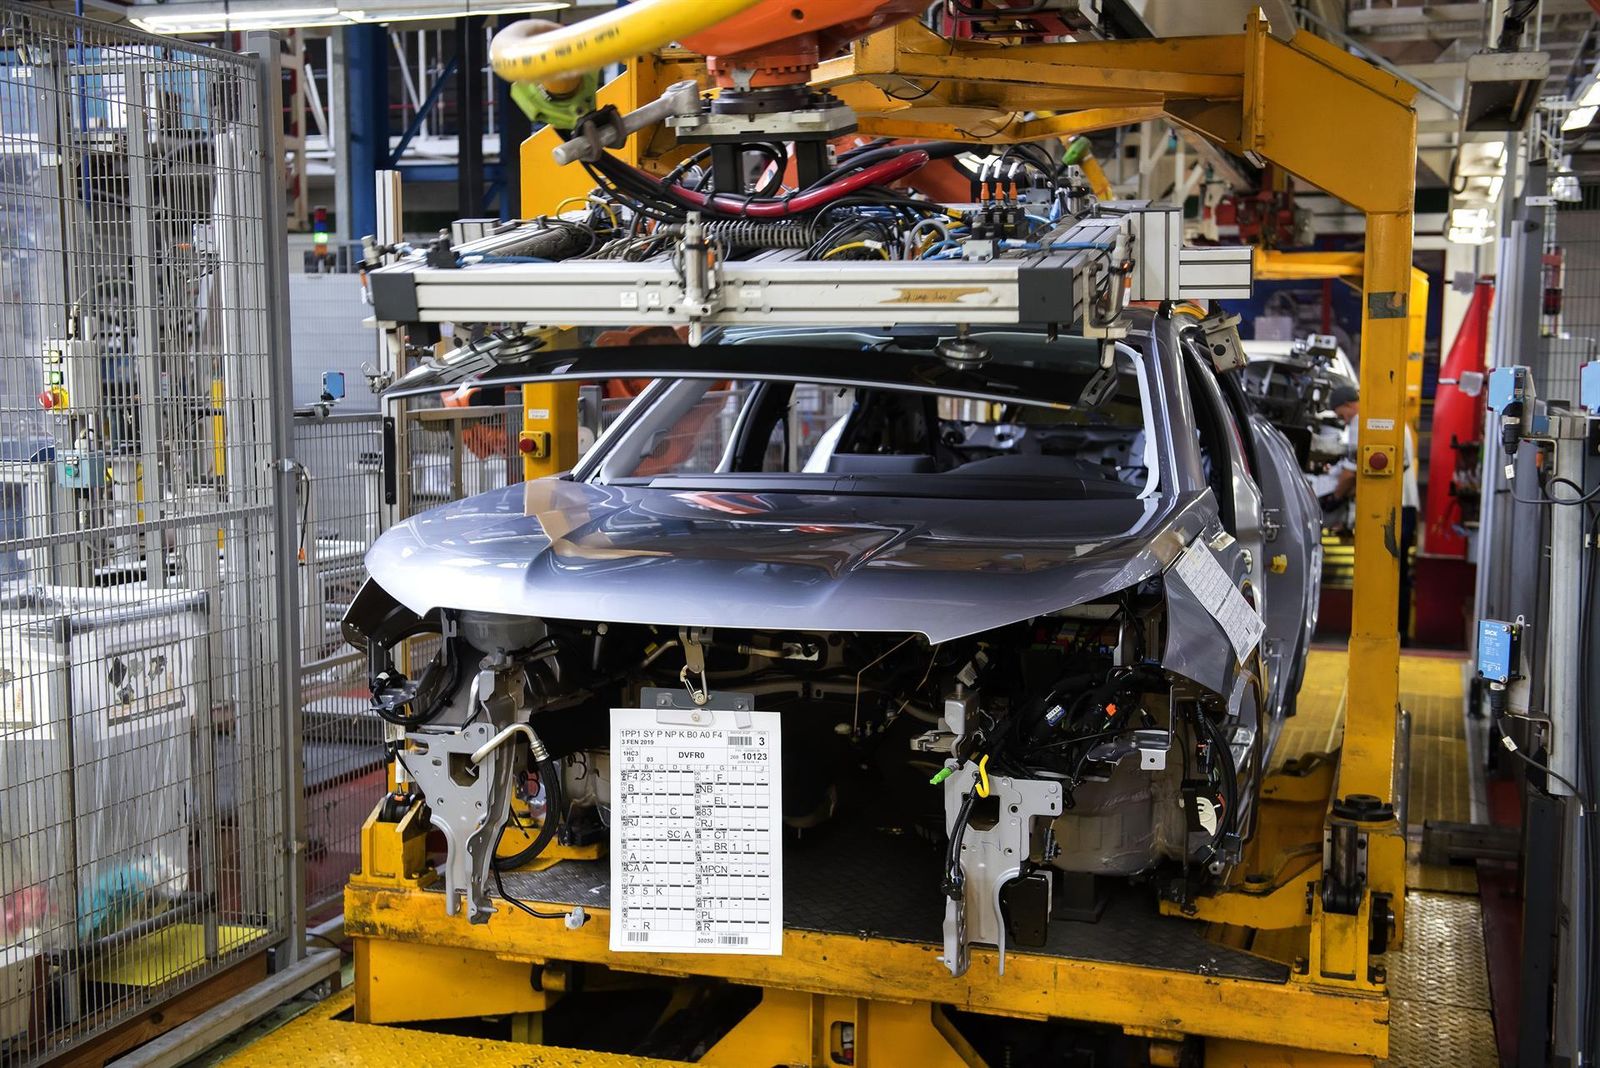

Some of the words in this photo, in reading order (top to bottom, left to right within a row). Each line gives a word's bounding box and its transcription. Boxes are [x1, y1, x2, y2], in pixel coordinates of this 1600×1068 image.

[759, 737, 765, 746] 3
[702, 911, 713, 919] PL
[704, 923, 710, 931] R
